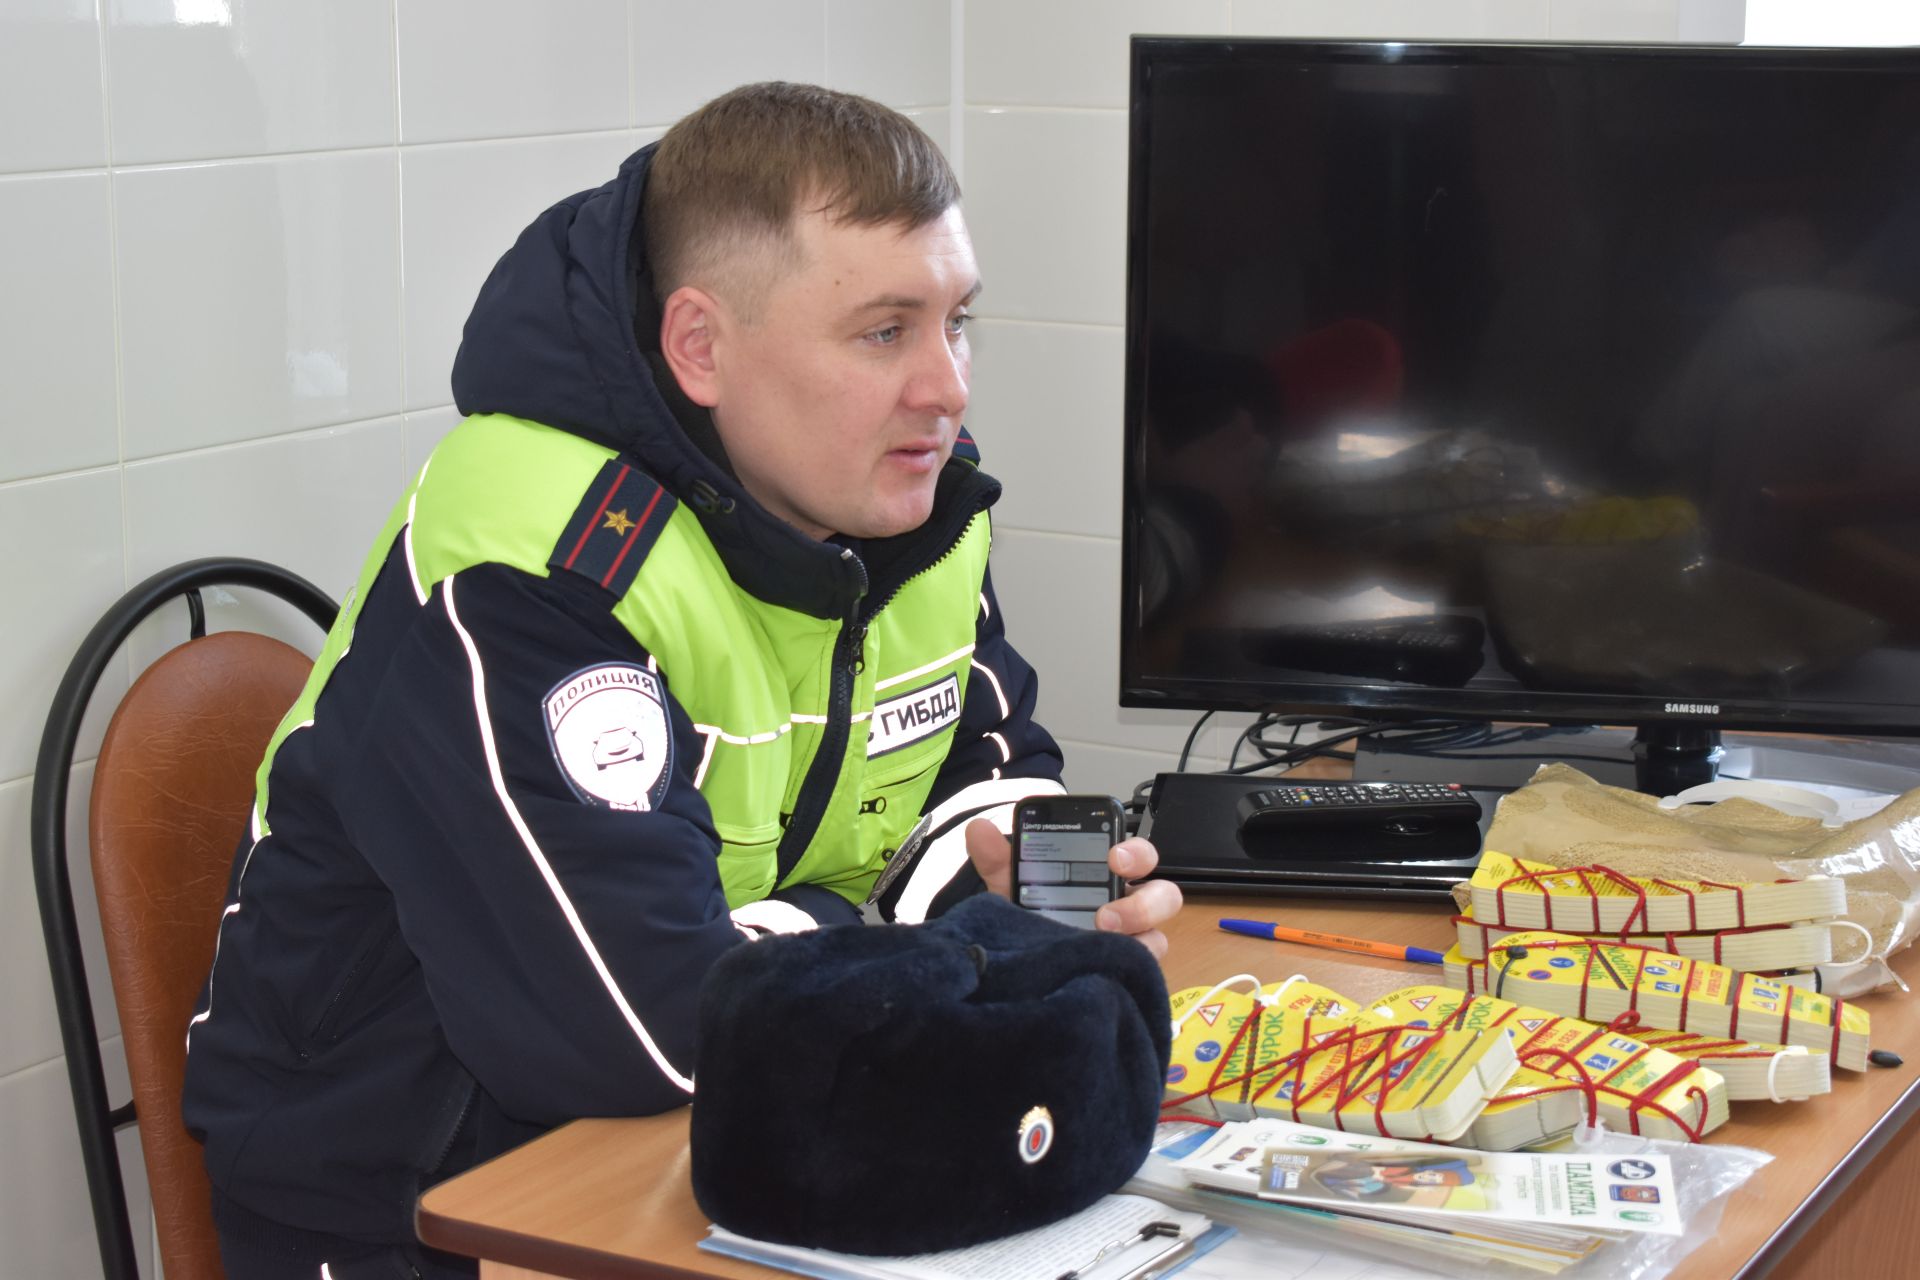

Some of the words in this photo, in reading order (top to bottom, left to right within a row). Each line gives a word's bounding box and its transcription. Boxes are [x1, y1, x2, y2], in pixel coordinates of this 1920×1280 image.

[553, 672, 656, 716] ПОЛИЦИЯ
[881, 686, 957, 736] ГИБДД
[1664, 703, 1719, 714] SAMSUNG
[1022, 822, 1041, 830] Центр
[1565, 1162, 1597, 1216] ПАМЯТКА
